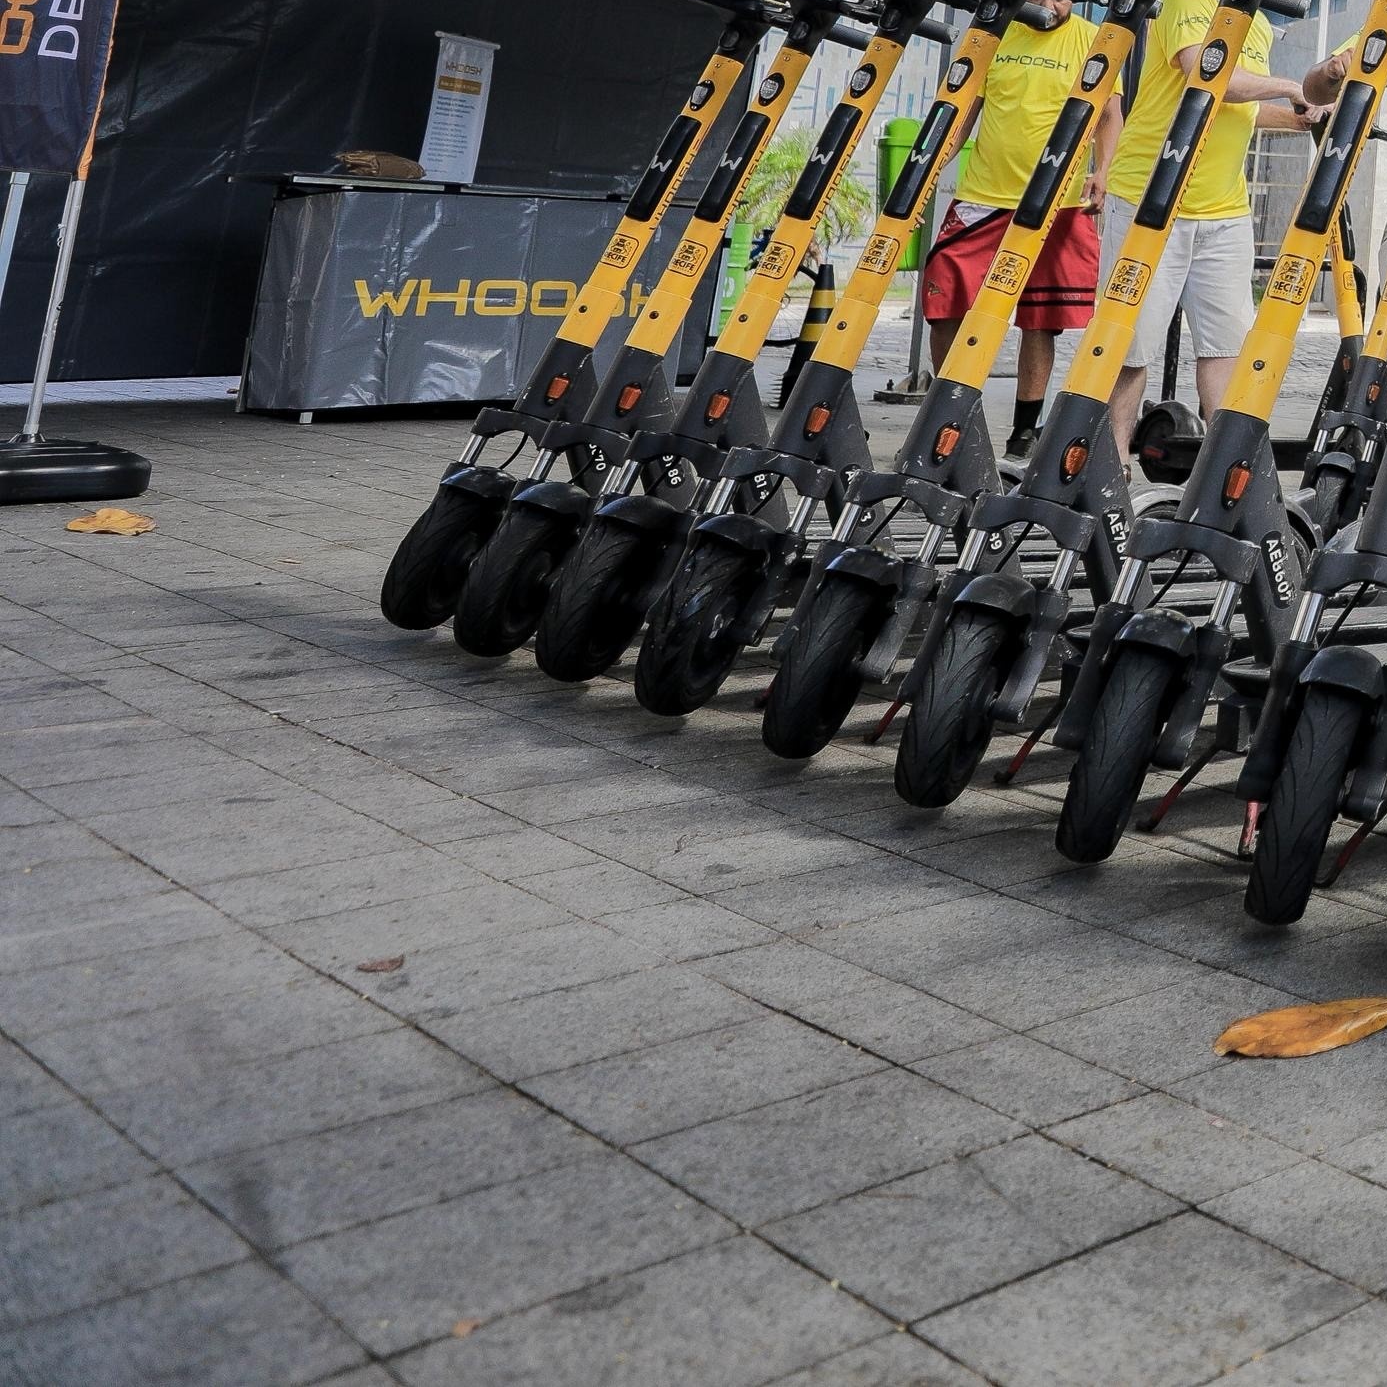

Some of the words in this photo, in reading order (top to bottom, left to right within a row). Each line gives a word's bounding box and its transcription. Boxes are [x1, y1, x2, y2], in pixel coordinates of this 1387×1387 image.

[995, 53, 1068, 72] WHOOSH
[1041, 146, 1067, 168] W
[1162, 140, 1189, 163] W
[1325, 138, 1352, 161] W
[761, 260, 783, 274] ECIFE
[990, 272, 1018, 290] RECIFE
[1273, 280, 1304, 297] RECIFE
[1110, 282, 1139, 299] RECIFE
